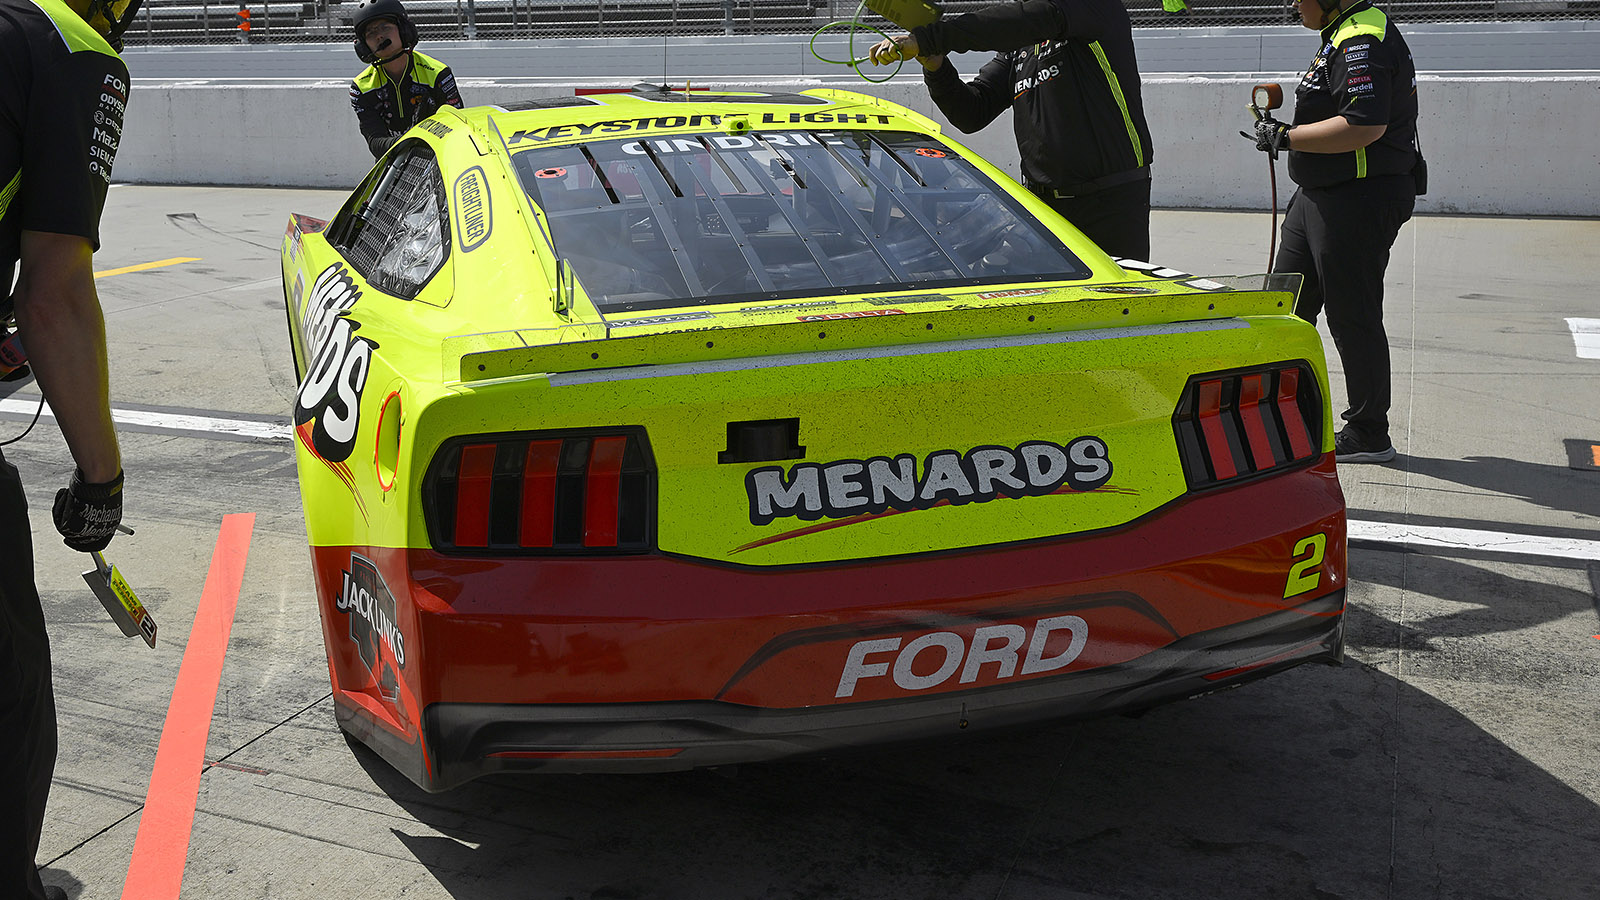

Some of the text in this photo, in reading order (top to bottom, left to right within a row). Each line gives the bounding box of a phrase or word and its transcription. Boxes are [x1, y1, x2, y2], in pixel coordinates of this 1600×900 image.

[1347, 83, 1373, 93] cardell
[508, 112, 894, 144] KEYSTON LIGHT
[460, 173, 485, 242] FREIGHTLINER
[826, 309, 902, 319] DELTA
[747, 436, 1110, 523] MENARDS
[1282, 532, 1327, 600] 2
[140, 614, 156, 639] 2
[337, 573, 405, 666] JACK LINK'S
[834, 614, 1089, 699] FORD
